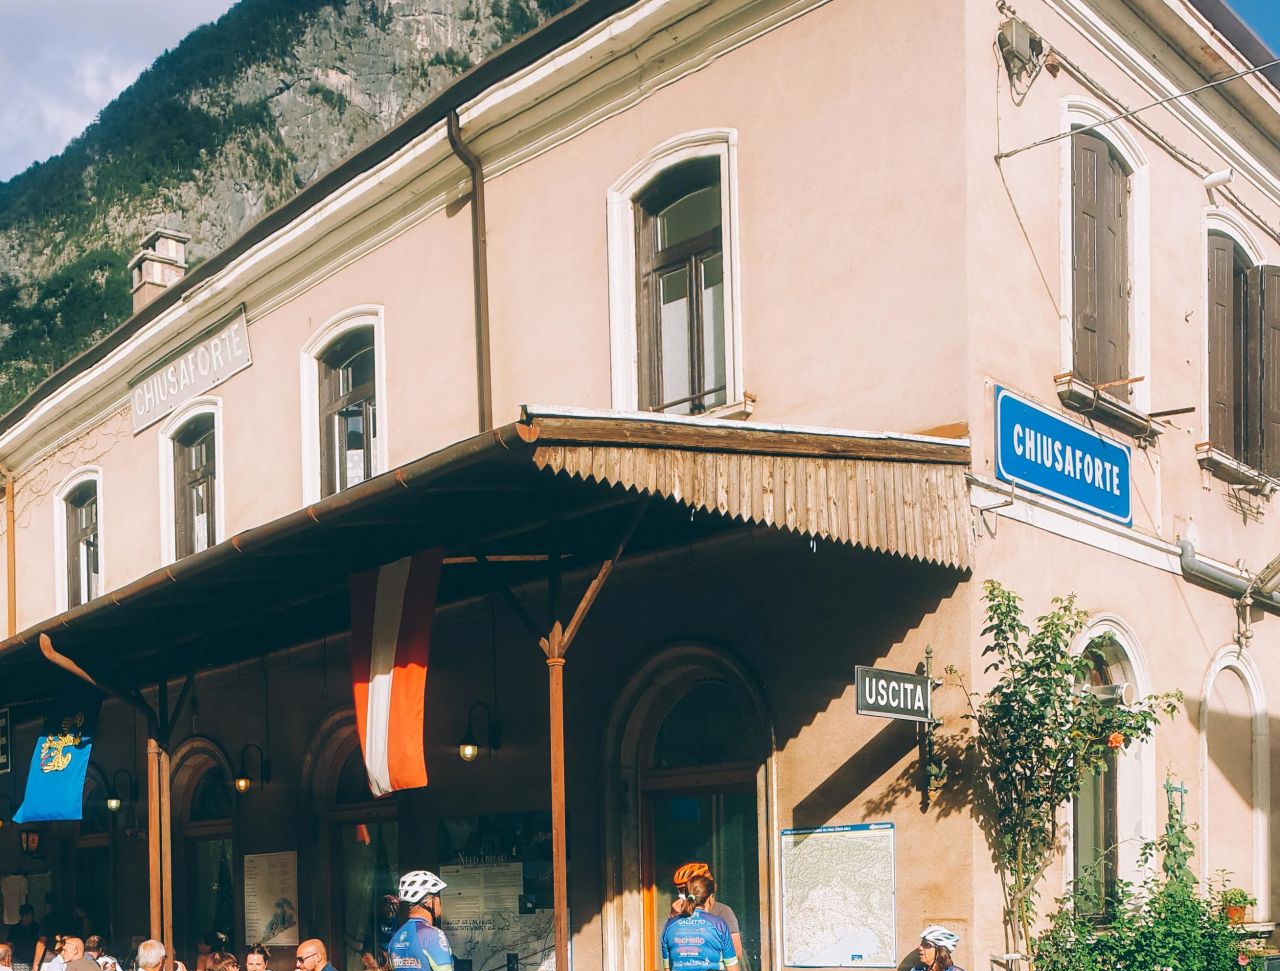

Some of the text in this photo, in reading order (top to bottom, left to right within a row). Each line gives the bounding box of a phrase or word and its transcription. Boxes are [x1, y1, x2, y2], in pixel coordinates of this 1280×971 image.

[134, 322, 243, 416] CHIUSAFORTE
[1013, 423, 1121, 496] CHIUSAFORTE
[865, 676, 925, 711] USCITA
